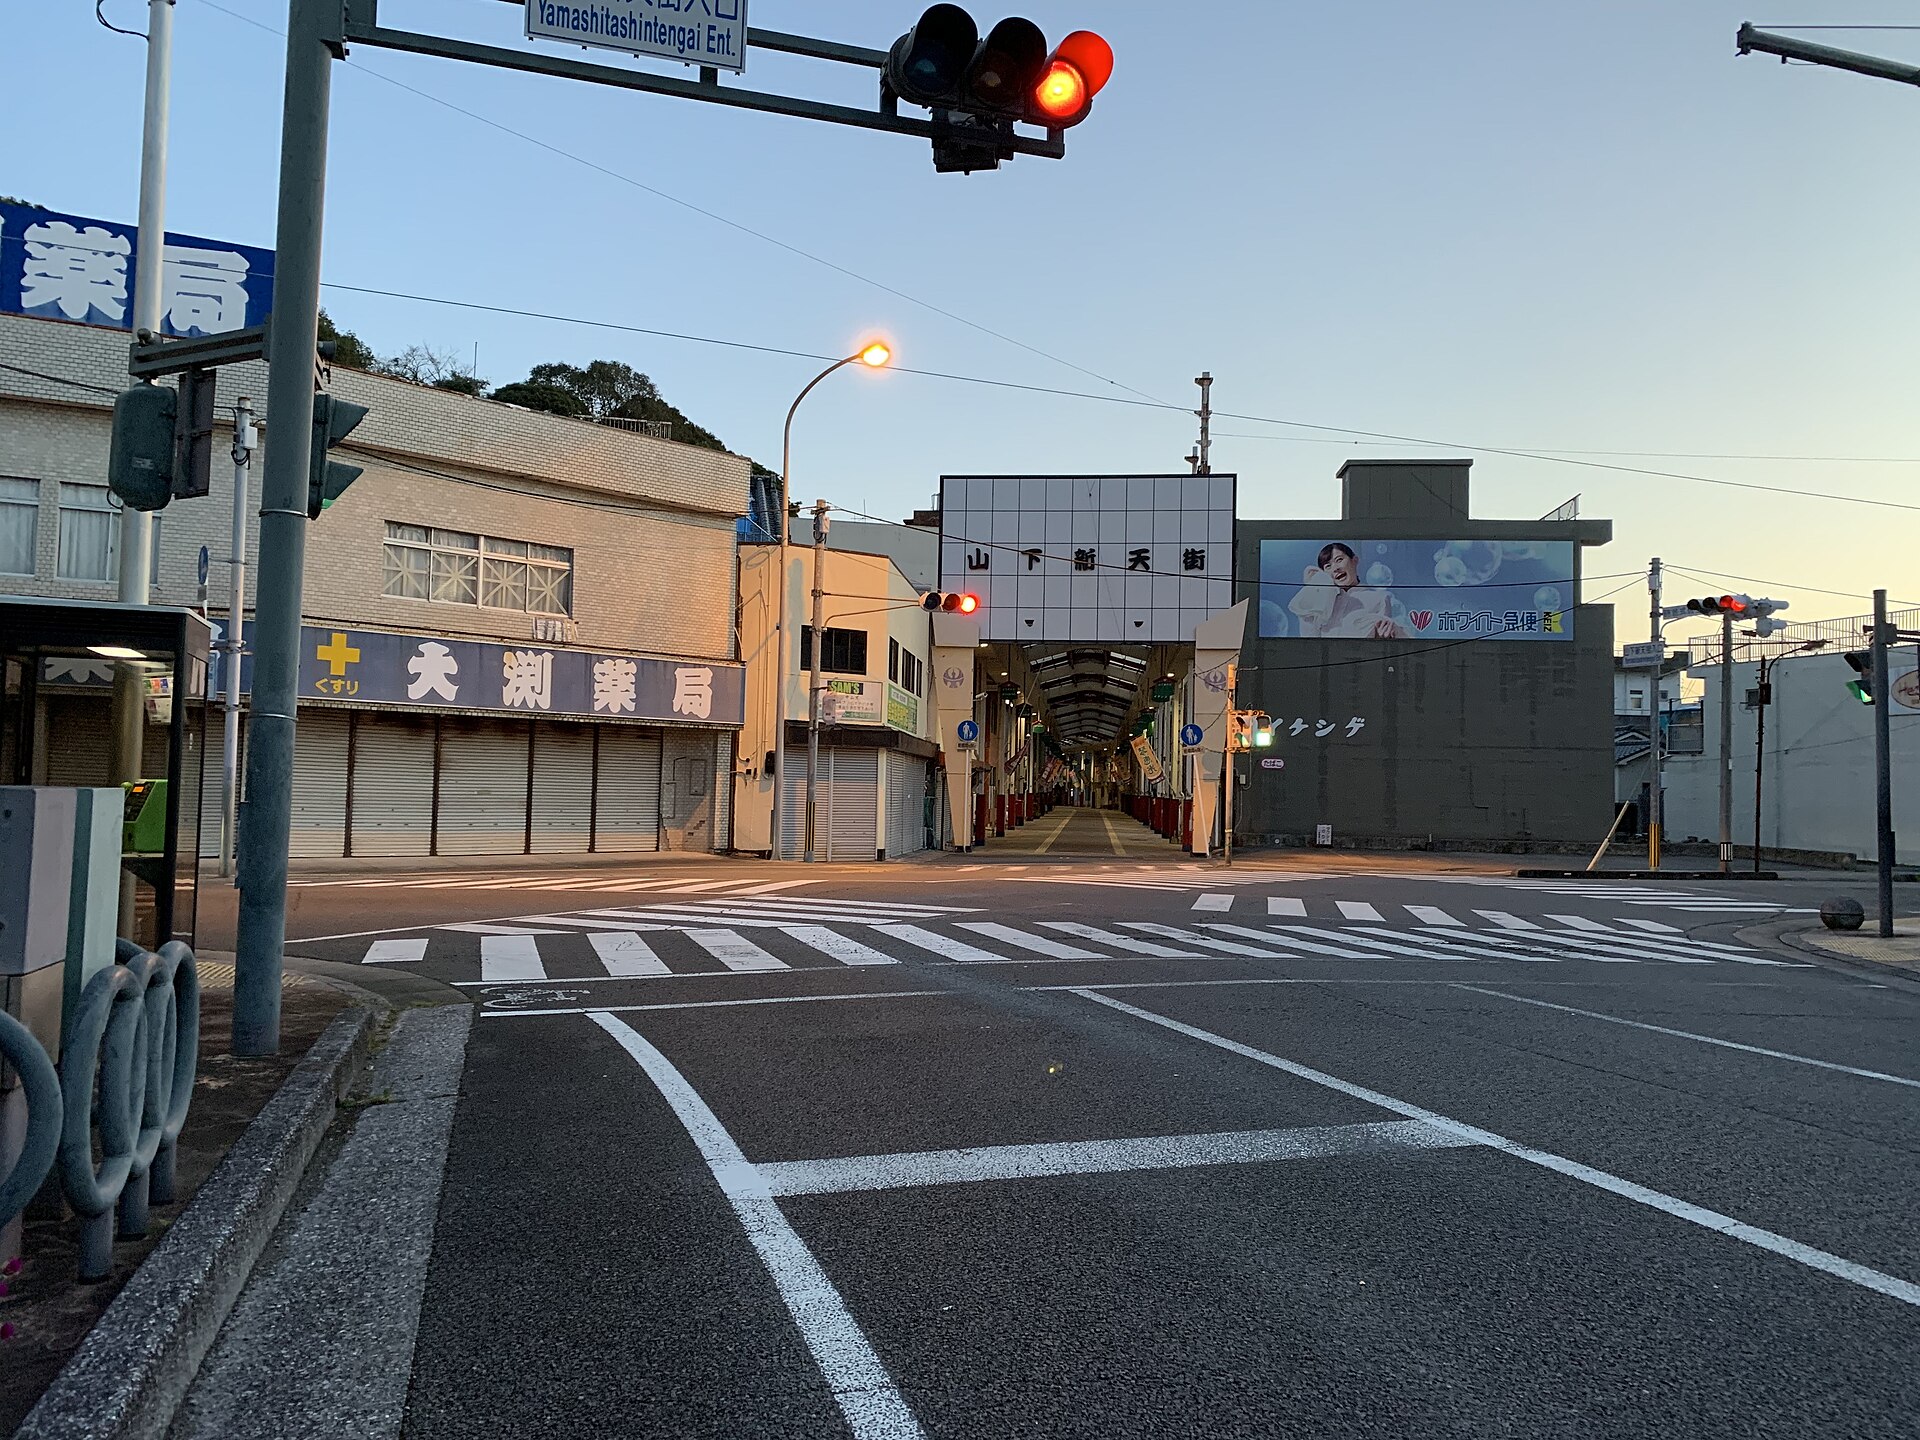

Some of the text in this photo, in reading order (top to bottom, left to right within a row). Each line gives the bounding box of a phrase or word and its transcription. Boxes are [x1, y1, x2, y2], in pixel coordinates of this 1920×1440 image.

[538, 2, 701, 54] Yamashitashintengai
[706, 24, 736, 57] Ent.
[0, 214, 250, 334] 薬局
[967, 547, 1206, 572] 山下新天街
[1438, 610, 1538, 632] ホワイト急便
[1543, 611, 1553, 633] KEIZ
[315, 677, 359, 696] くすり
[830, 681, 860, 695] SAM'S
